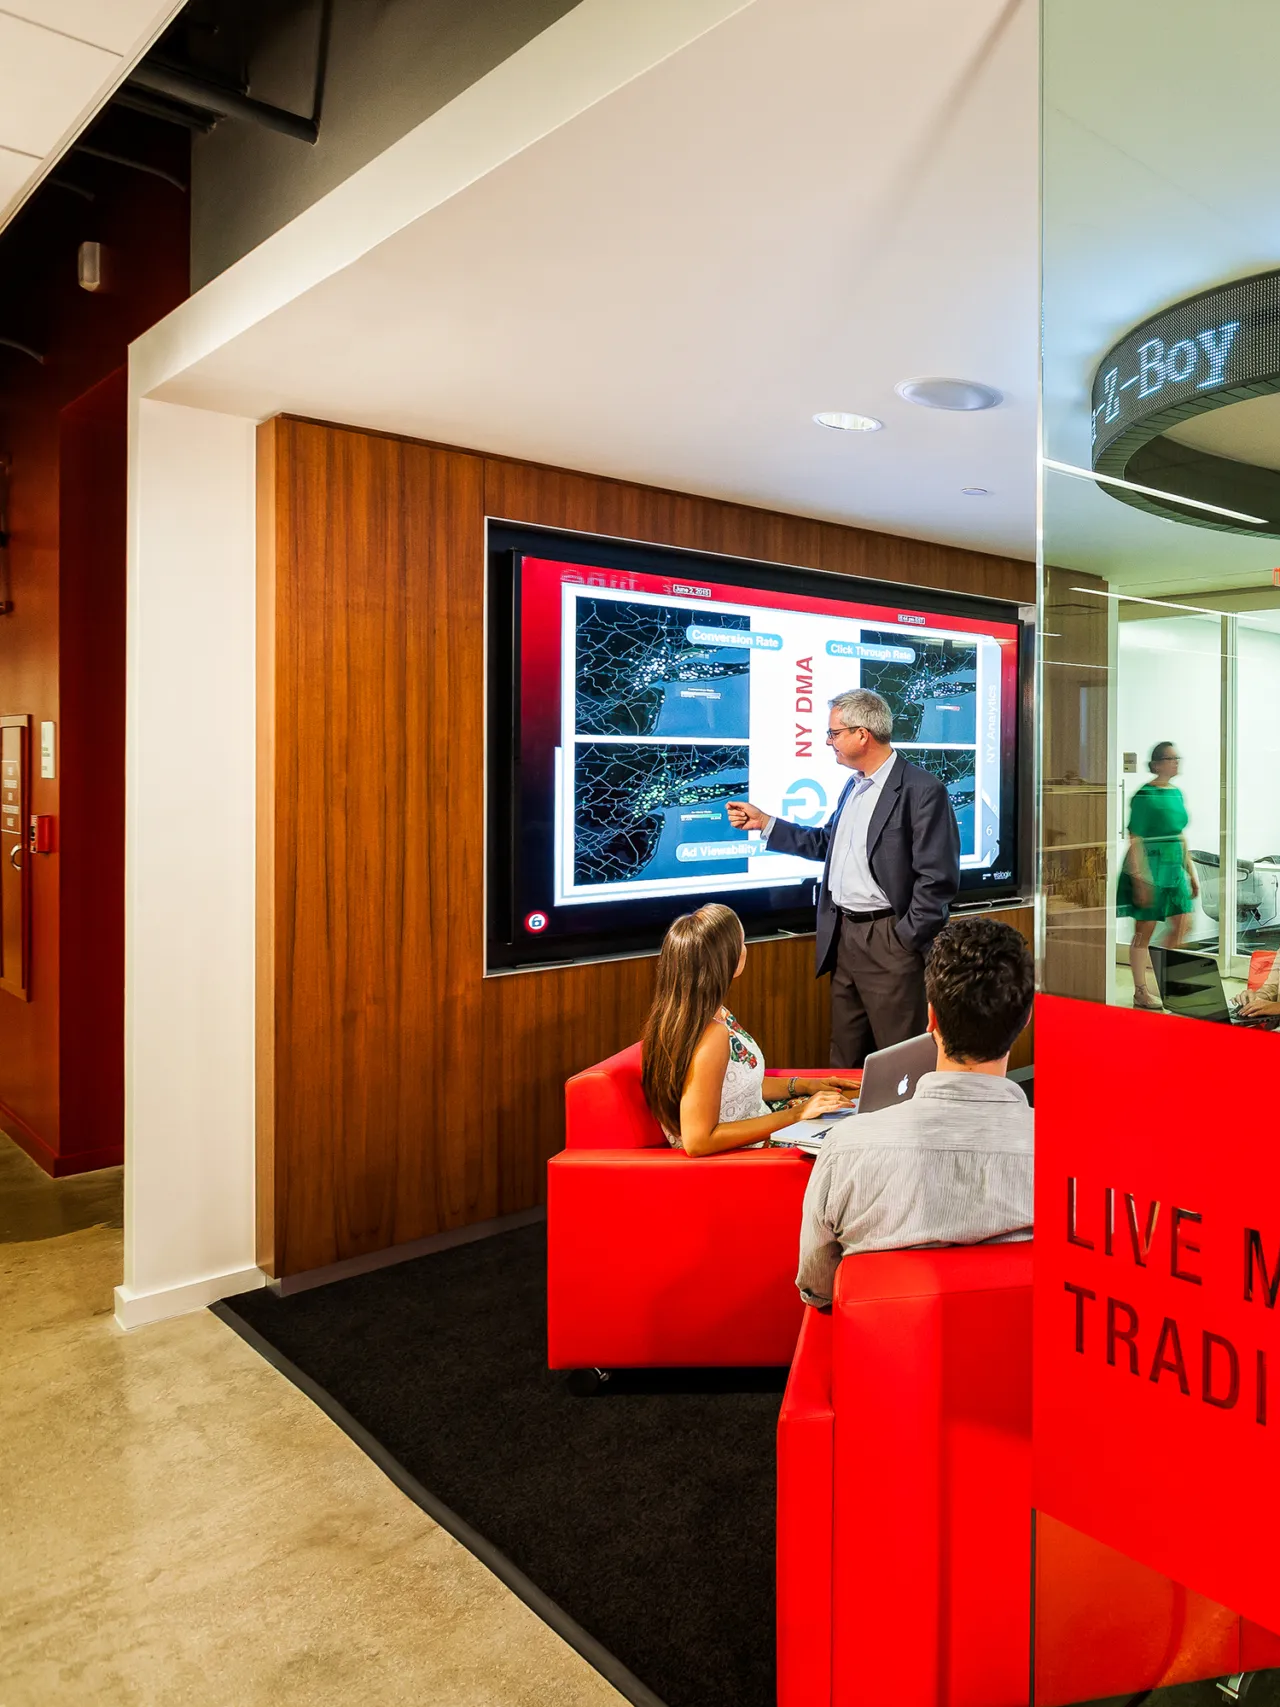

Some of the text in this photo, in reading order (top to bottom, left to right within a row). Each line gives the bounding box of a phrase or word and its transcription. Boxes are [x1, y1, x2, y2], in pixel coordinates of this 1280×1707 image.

[691, 629, 780, 648] Conversion Rate
[830, 643, 912, 661] Click Through Rate
[795, 656, 813, 757] NY DMA
[986, 684, 997, 764] NY Analytics
[985, 824, 993, 837] 6
[681, 846, 697, 858] Ad
[700, 843, 757, 858] Viewability
[1064, 1175, 1204, 1286] LIVE
